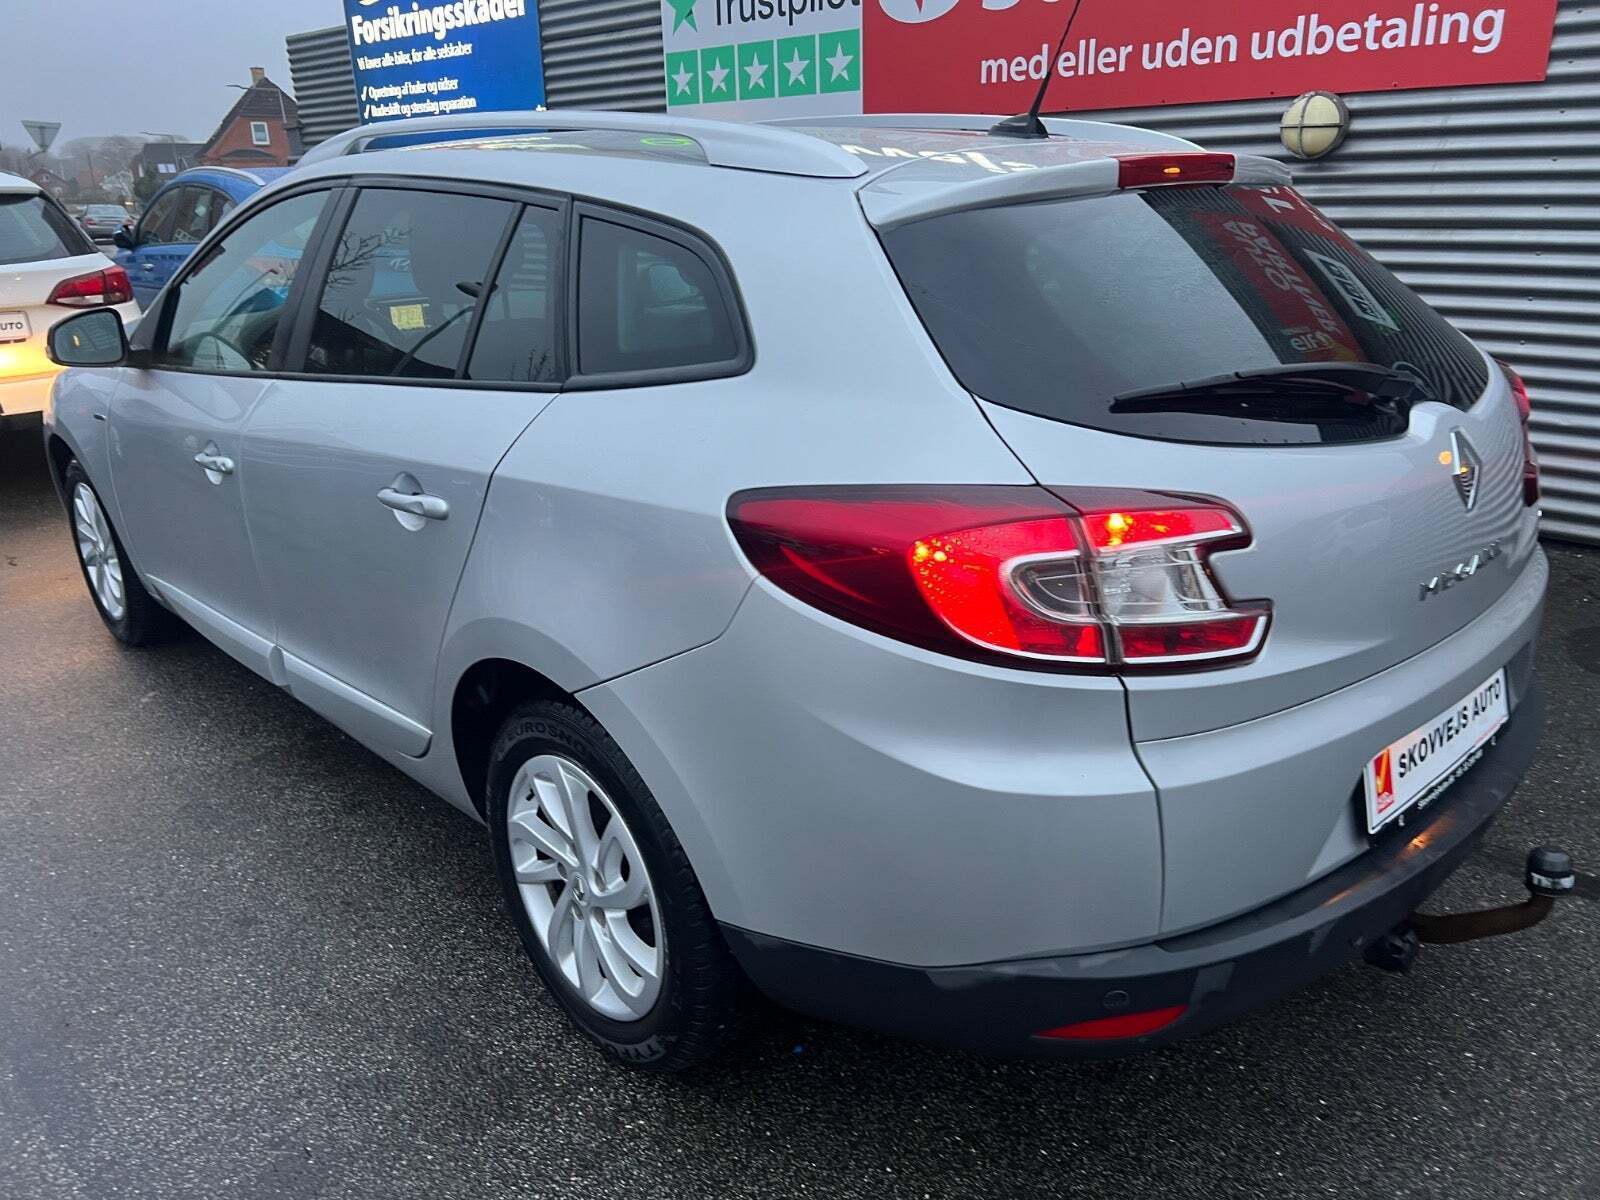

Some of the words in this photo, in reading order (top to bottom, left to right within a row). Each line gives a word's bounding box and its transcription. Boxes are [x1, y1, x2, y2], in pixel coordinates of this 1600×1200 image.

[351, 0, 526, 46] Forsikringsskader
[714, 0, 859, 25] Trustp
[412, 48, 423, 62] for
[423, 46, 437, 60] alle
[437, 41, 473, 59] selskaber
[980, 43, 1048, 84] med
[1057, 38, 1132, 78] eller
[1141, 28, 1237, 72] uden
[1250, 3, 1505, 61] udbetaling
[427, 81, 438, 95] og
[401, 104, 412, 117] og
[439, 95, 477, 114] reparation
[0, 322, 23, 330] UTO
[1398, 705, 1468, 779] SKOVVEJS
[1471, 677, 1501, 721] AUTO
